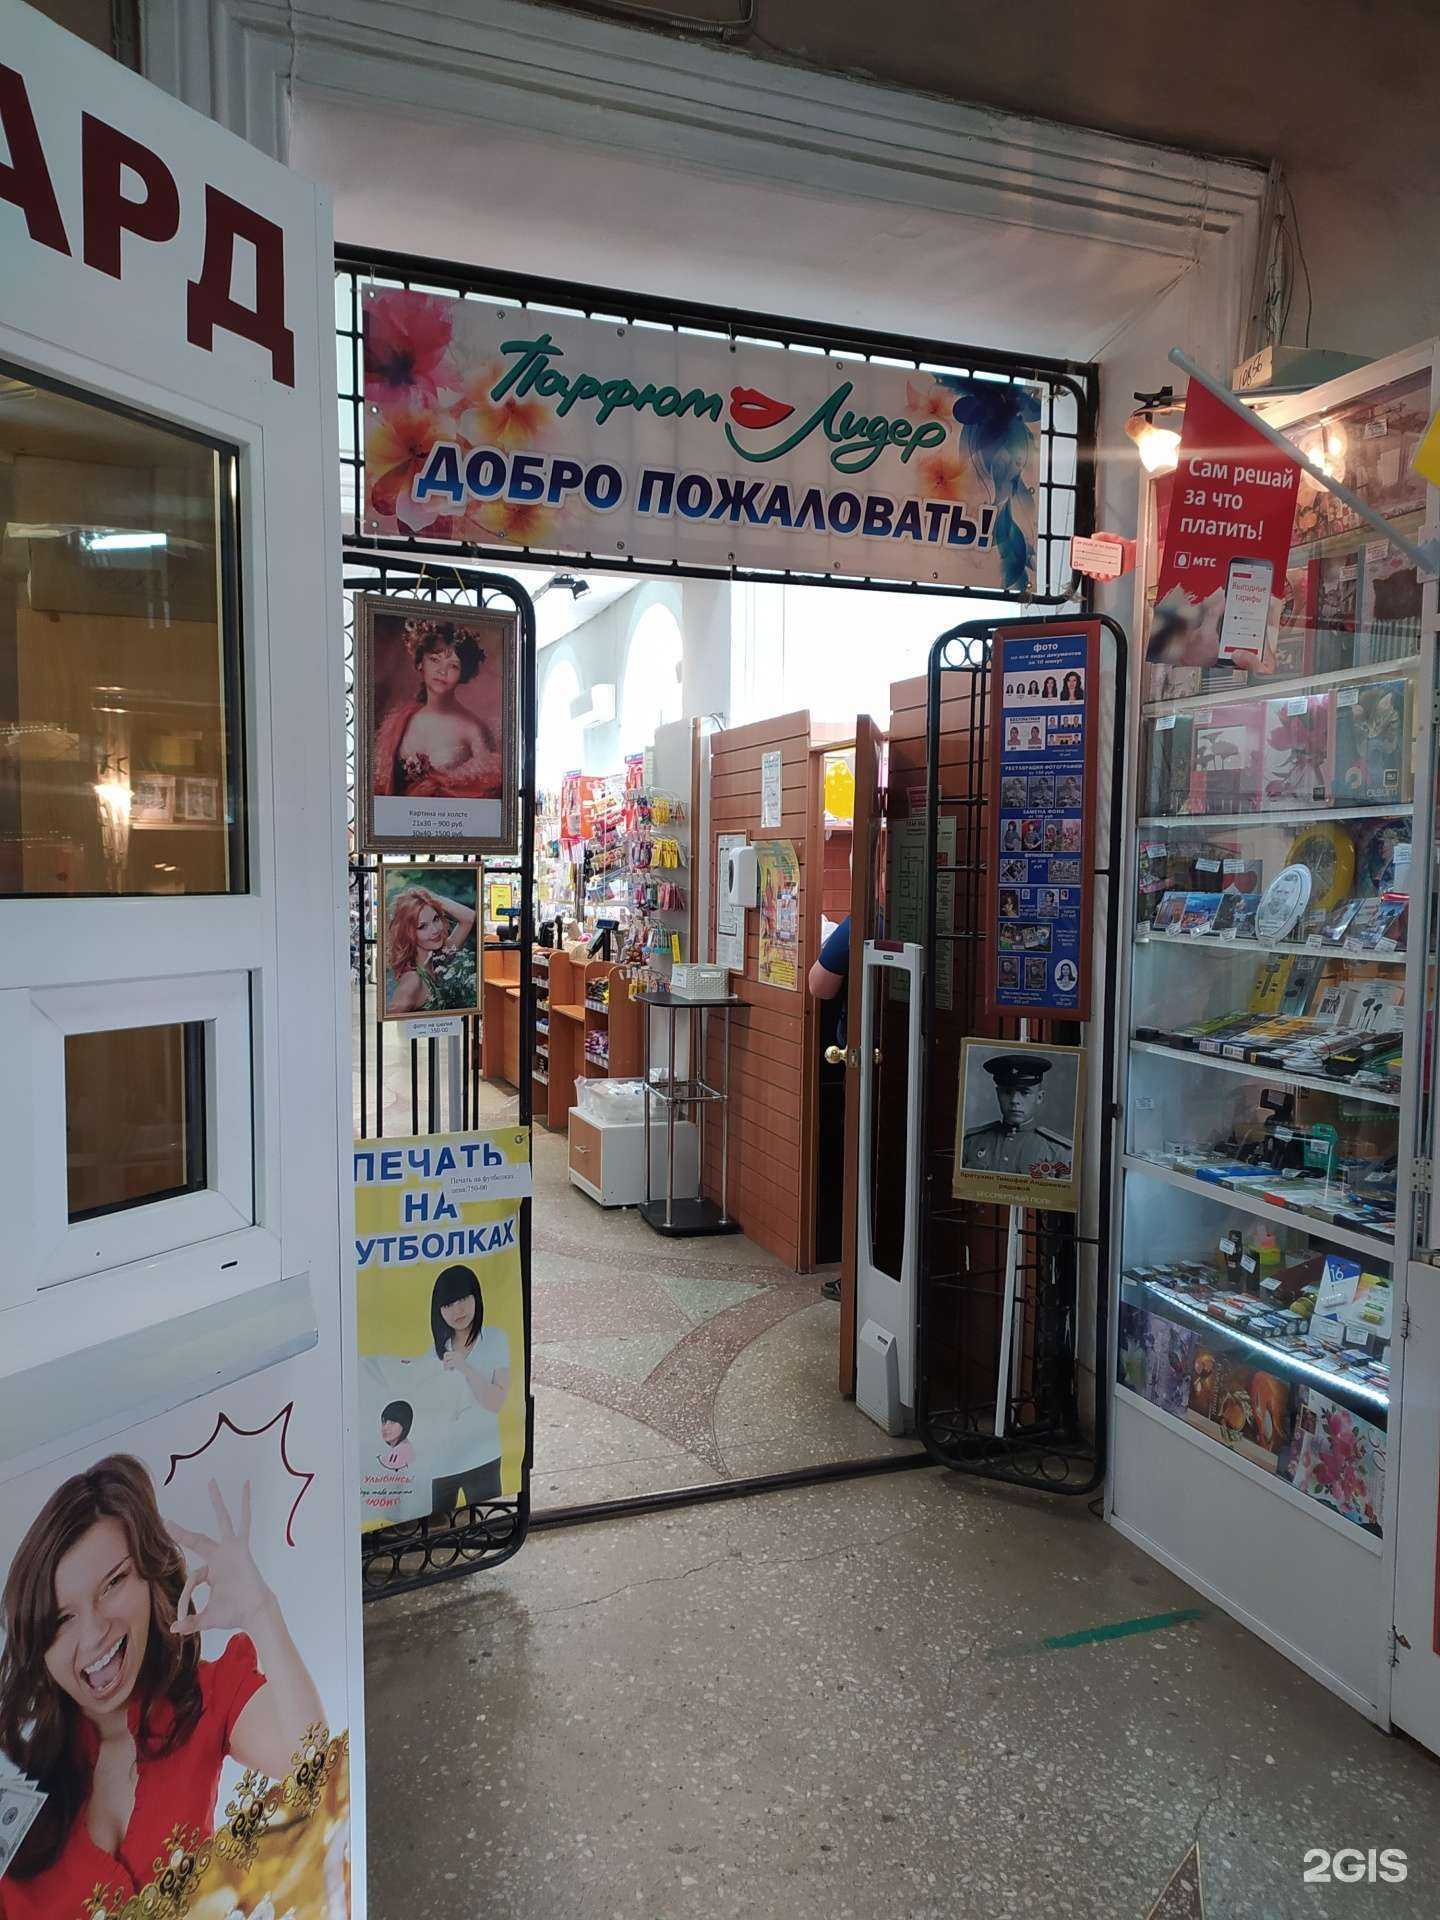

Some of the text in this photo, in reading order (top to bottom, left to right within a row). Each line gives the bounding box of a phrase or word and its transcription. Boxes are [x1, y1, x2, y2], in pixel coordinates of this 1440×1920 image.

[491, 334, 946, 474] Парфюм Лидер
[1189, 459, 1293, 490] Сам решай
[415, 446, 997, 548] ДОБРО ПОЖАЛОВАТЬ!
[1184, 490, 1243, 510] за что
[1180, 516, 1264, 541] платить!
[354, 1143, 502, 1182] ПЕЧАТЬ
[405, 1192, 458, 1222] НА
[355, 1219, 514, 1265] УТБОЛКАХ
